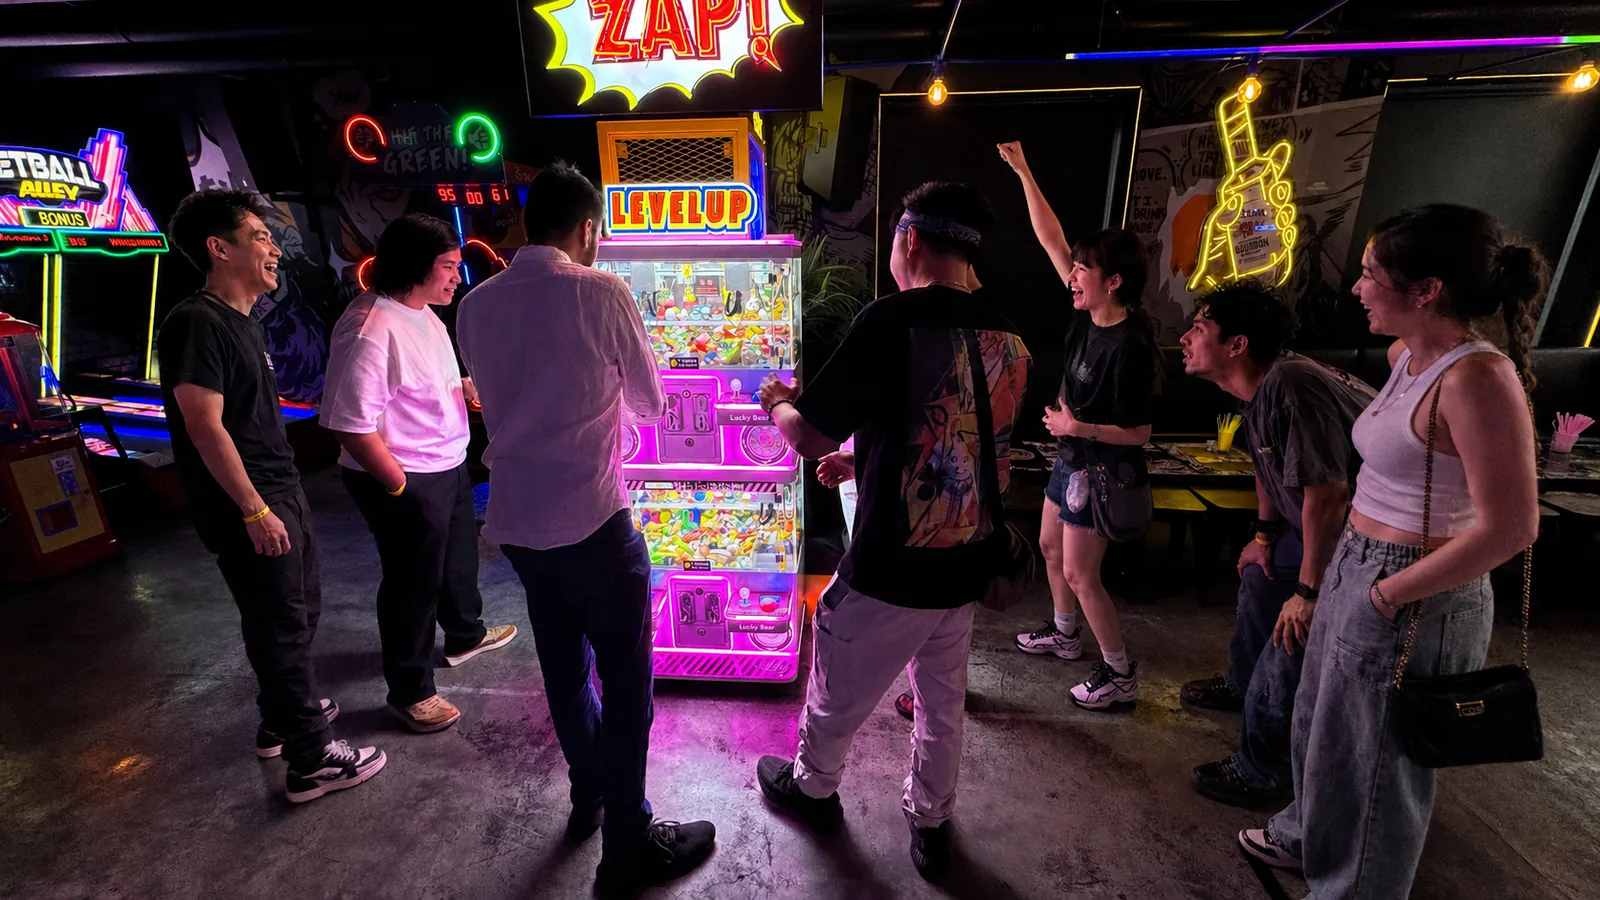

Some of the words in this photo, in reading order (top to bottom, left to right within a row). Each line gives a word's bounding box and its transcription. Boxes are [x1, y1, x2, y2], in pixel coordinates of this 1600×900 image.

[590, 0, 770, 65] ZAP!
[422, 123, 453, 144] THE
[383, 146, 468, 176] GREEN!
[19, 180, 80, 201] ALLEY
[437, 188, 457, 202] 95
[465, 190, 484, 205] 00
[38, 211, 85, 227] BONUS
[730, 414, 751, 422] Lucky
[739, 624, 759, 632] Lucky
